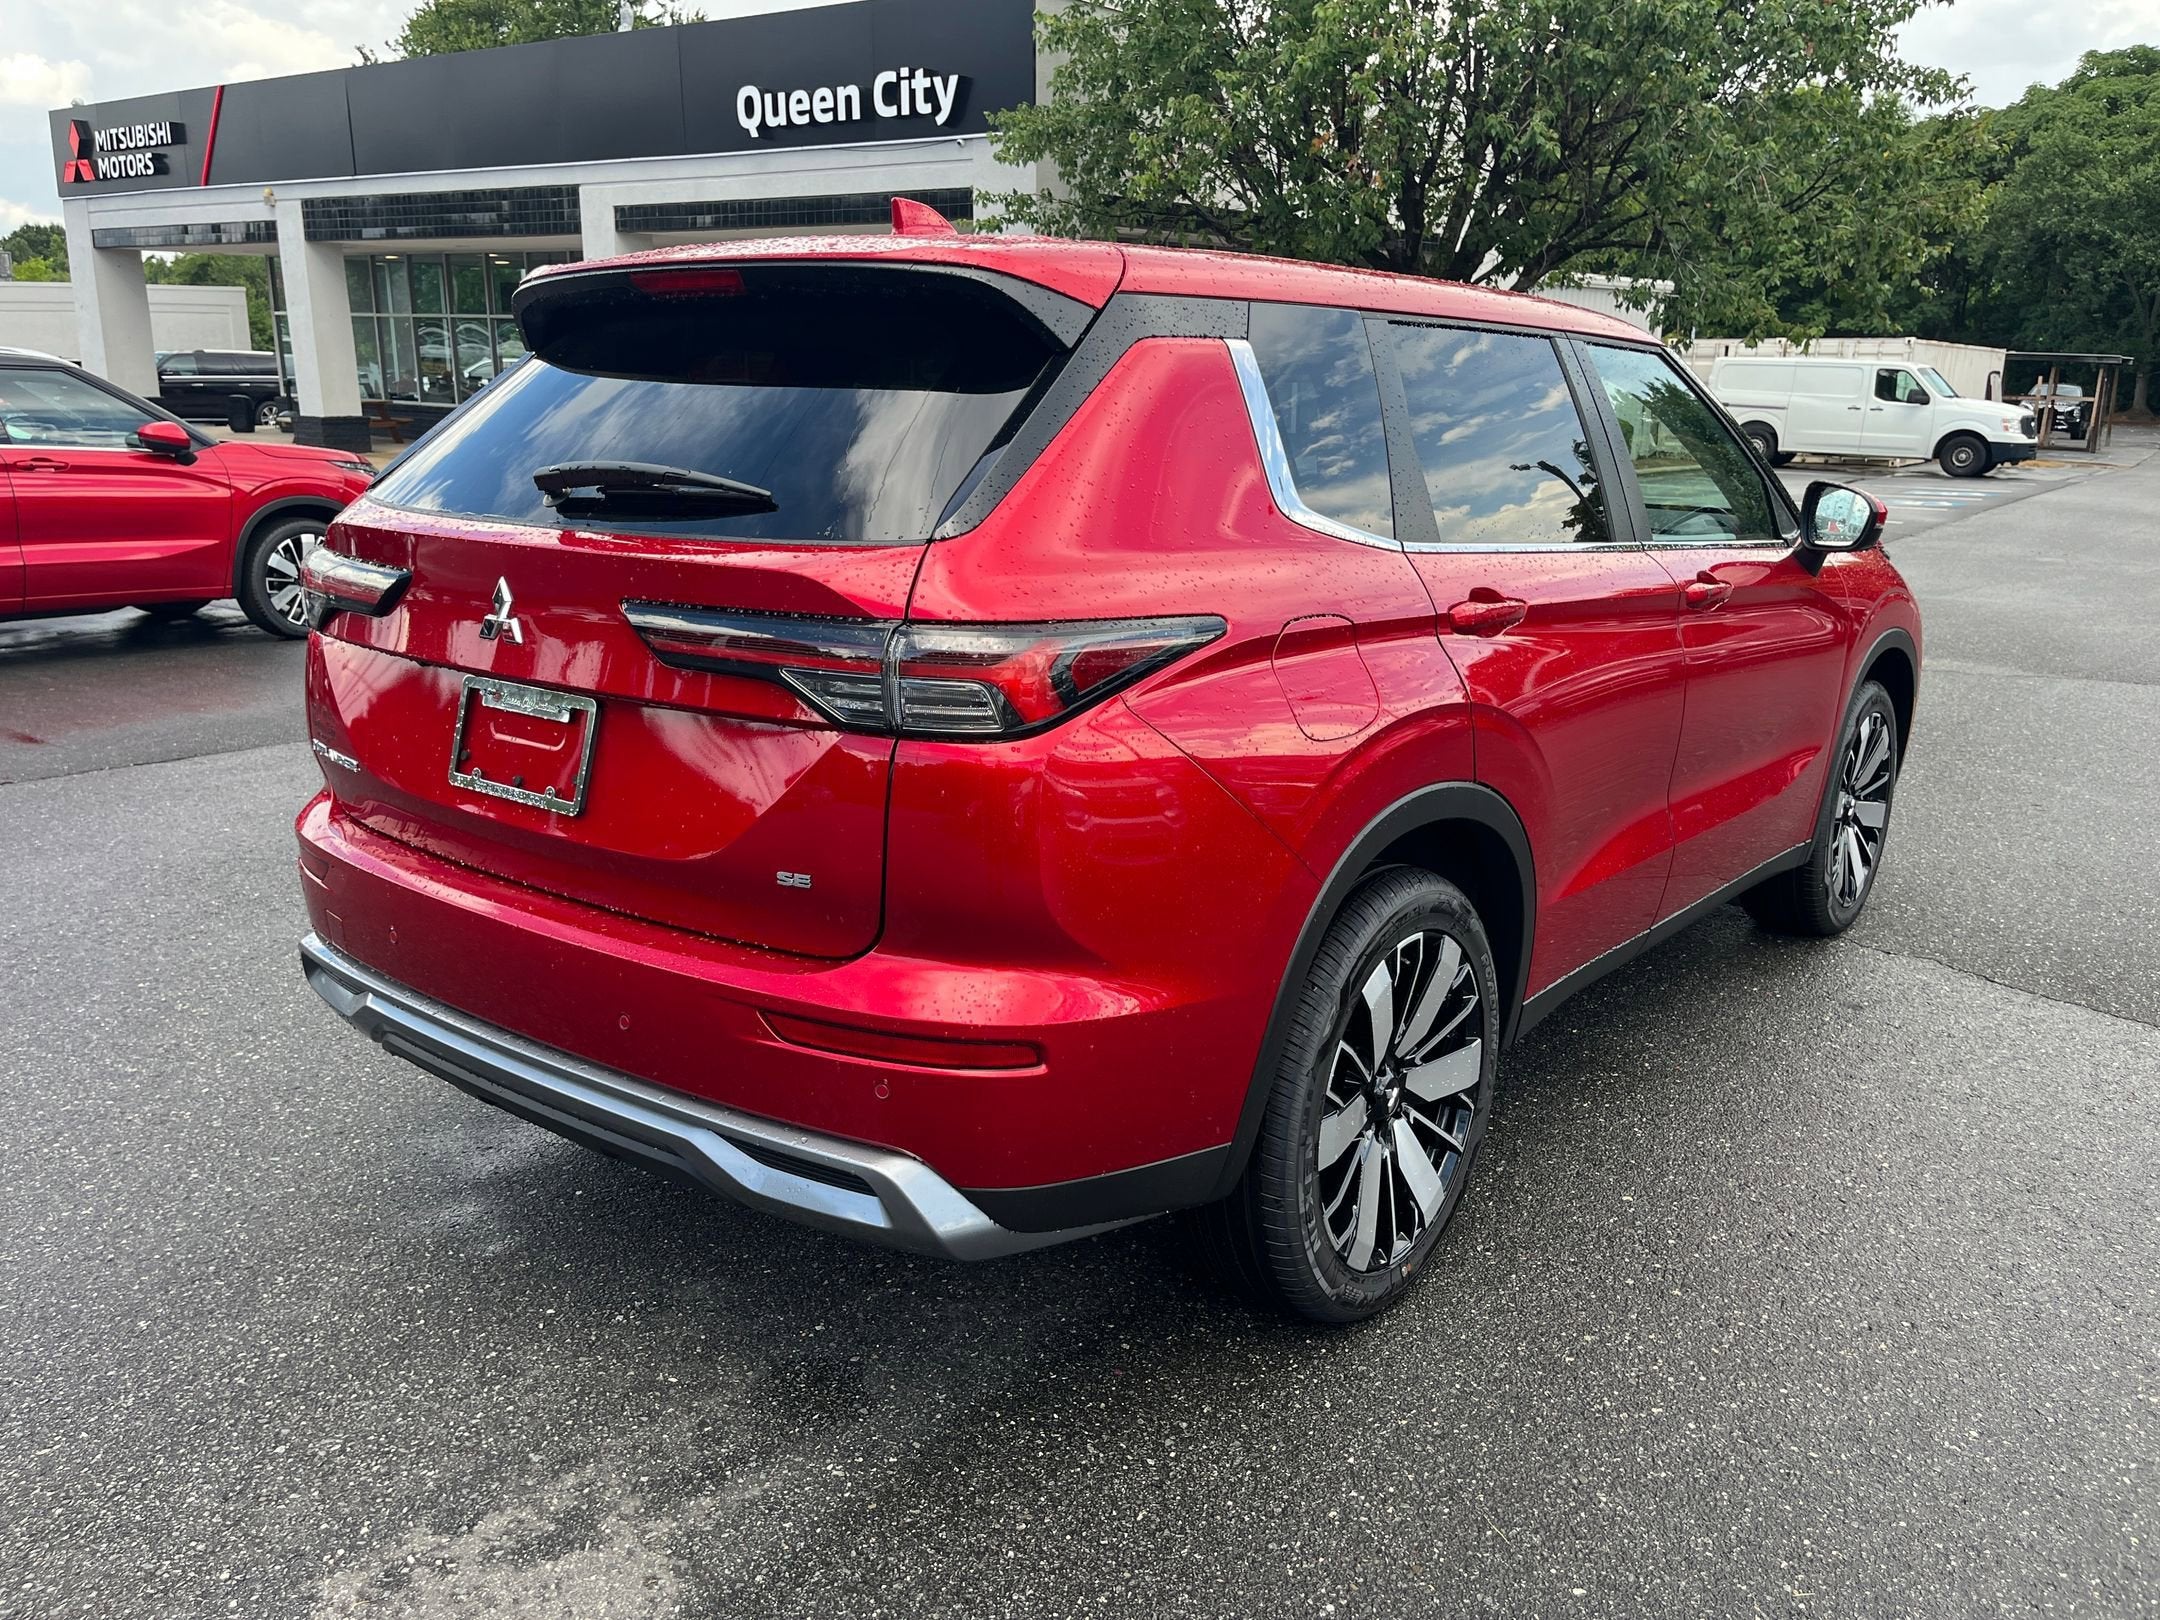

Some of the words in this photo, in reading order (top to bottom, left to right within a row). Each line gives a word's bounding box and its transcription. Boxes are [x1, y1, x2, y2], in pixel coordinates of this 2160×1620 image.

[736, 84, 861, 138] Queen
[873, 66, 959, 126] City
[94, 121, 172, 152] MITSUBISHI
[97, 152, 155, 180] MOTORS
[776, 871, 812, 889] SE
[1303, 1135, 1322, 1253] NEXEN
